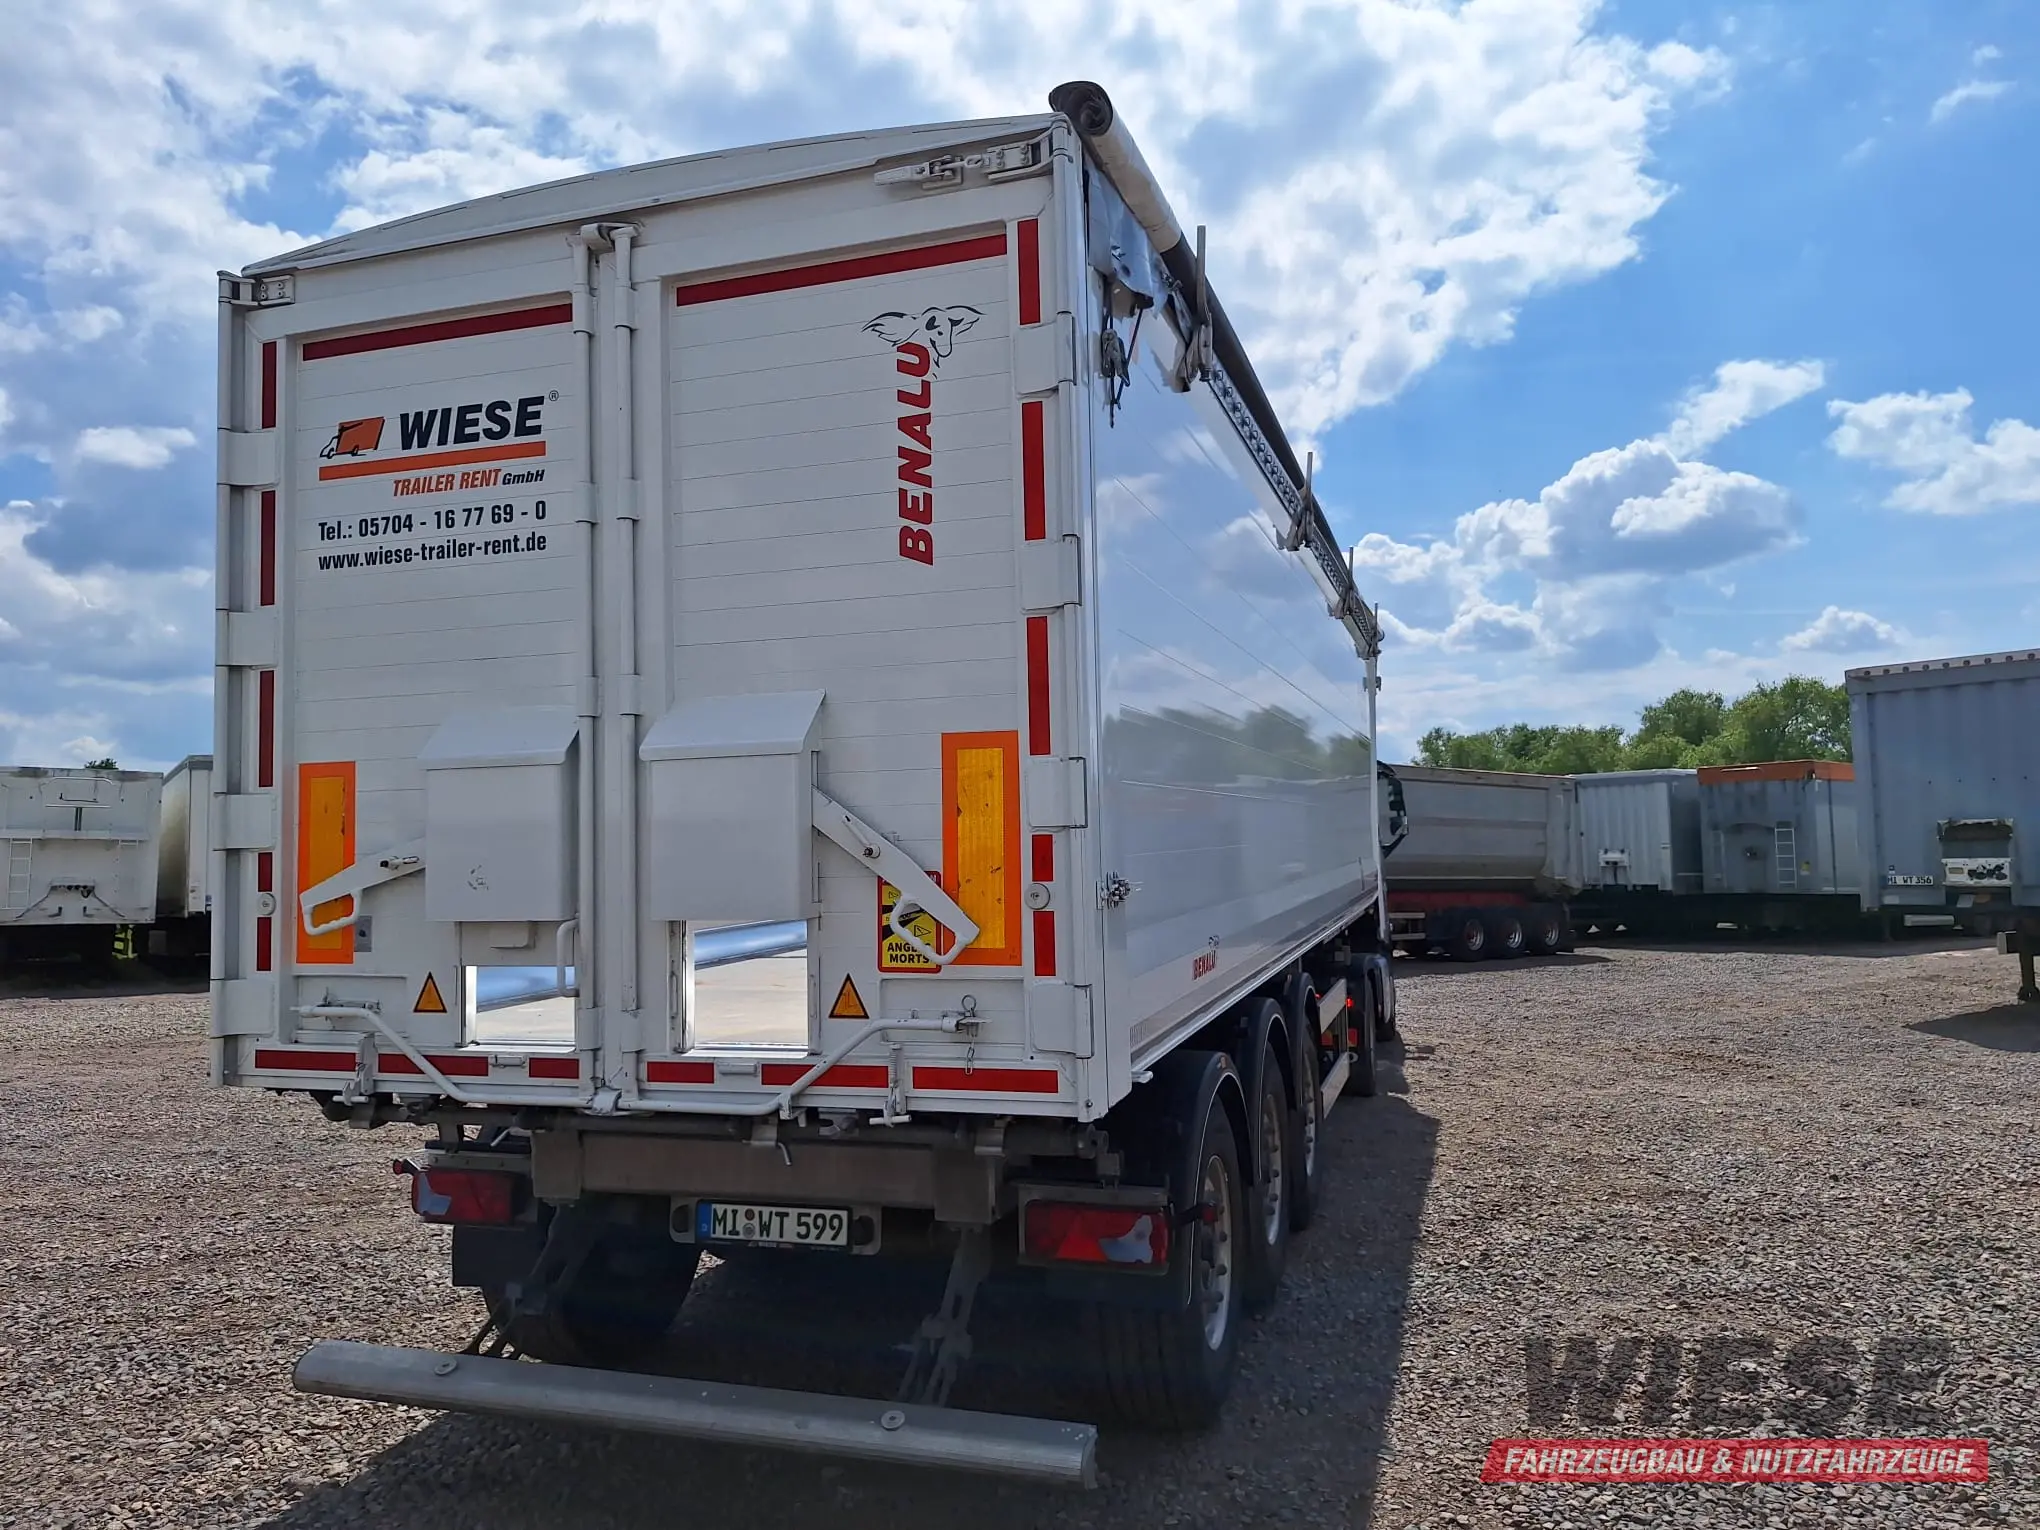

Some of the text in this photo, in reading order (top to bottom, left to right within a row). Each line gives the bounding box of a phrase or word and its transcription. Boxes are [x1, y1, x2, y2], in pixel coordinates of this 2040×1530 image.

[400, 395, 545, 451] WIESE
[897, 341, 933, 566] BENALU
[393, 469, 545, 497] TRAILER RENT GmbH
[318, 522, 353, 541] Tel.:
[358, 514, 413, 537] 05704
[434, 510, 455, 529] 16
[462, 507, 484, 527] 77
[491, 503, 514, 524] 69
[535, 500, 546, 520] 0
[318, 532, 547, 570] www.wiese-trailer-rent.de
[712, 1208, 740, 1236] MI
[758, 1210, 790, 1239] WT
[796, 1212, 844, 1241] 599
